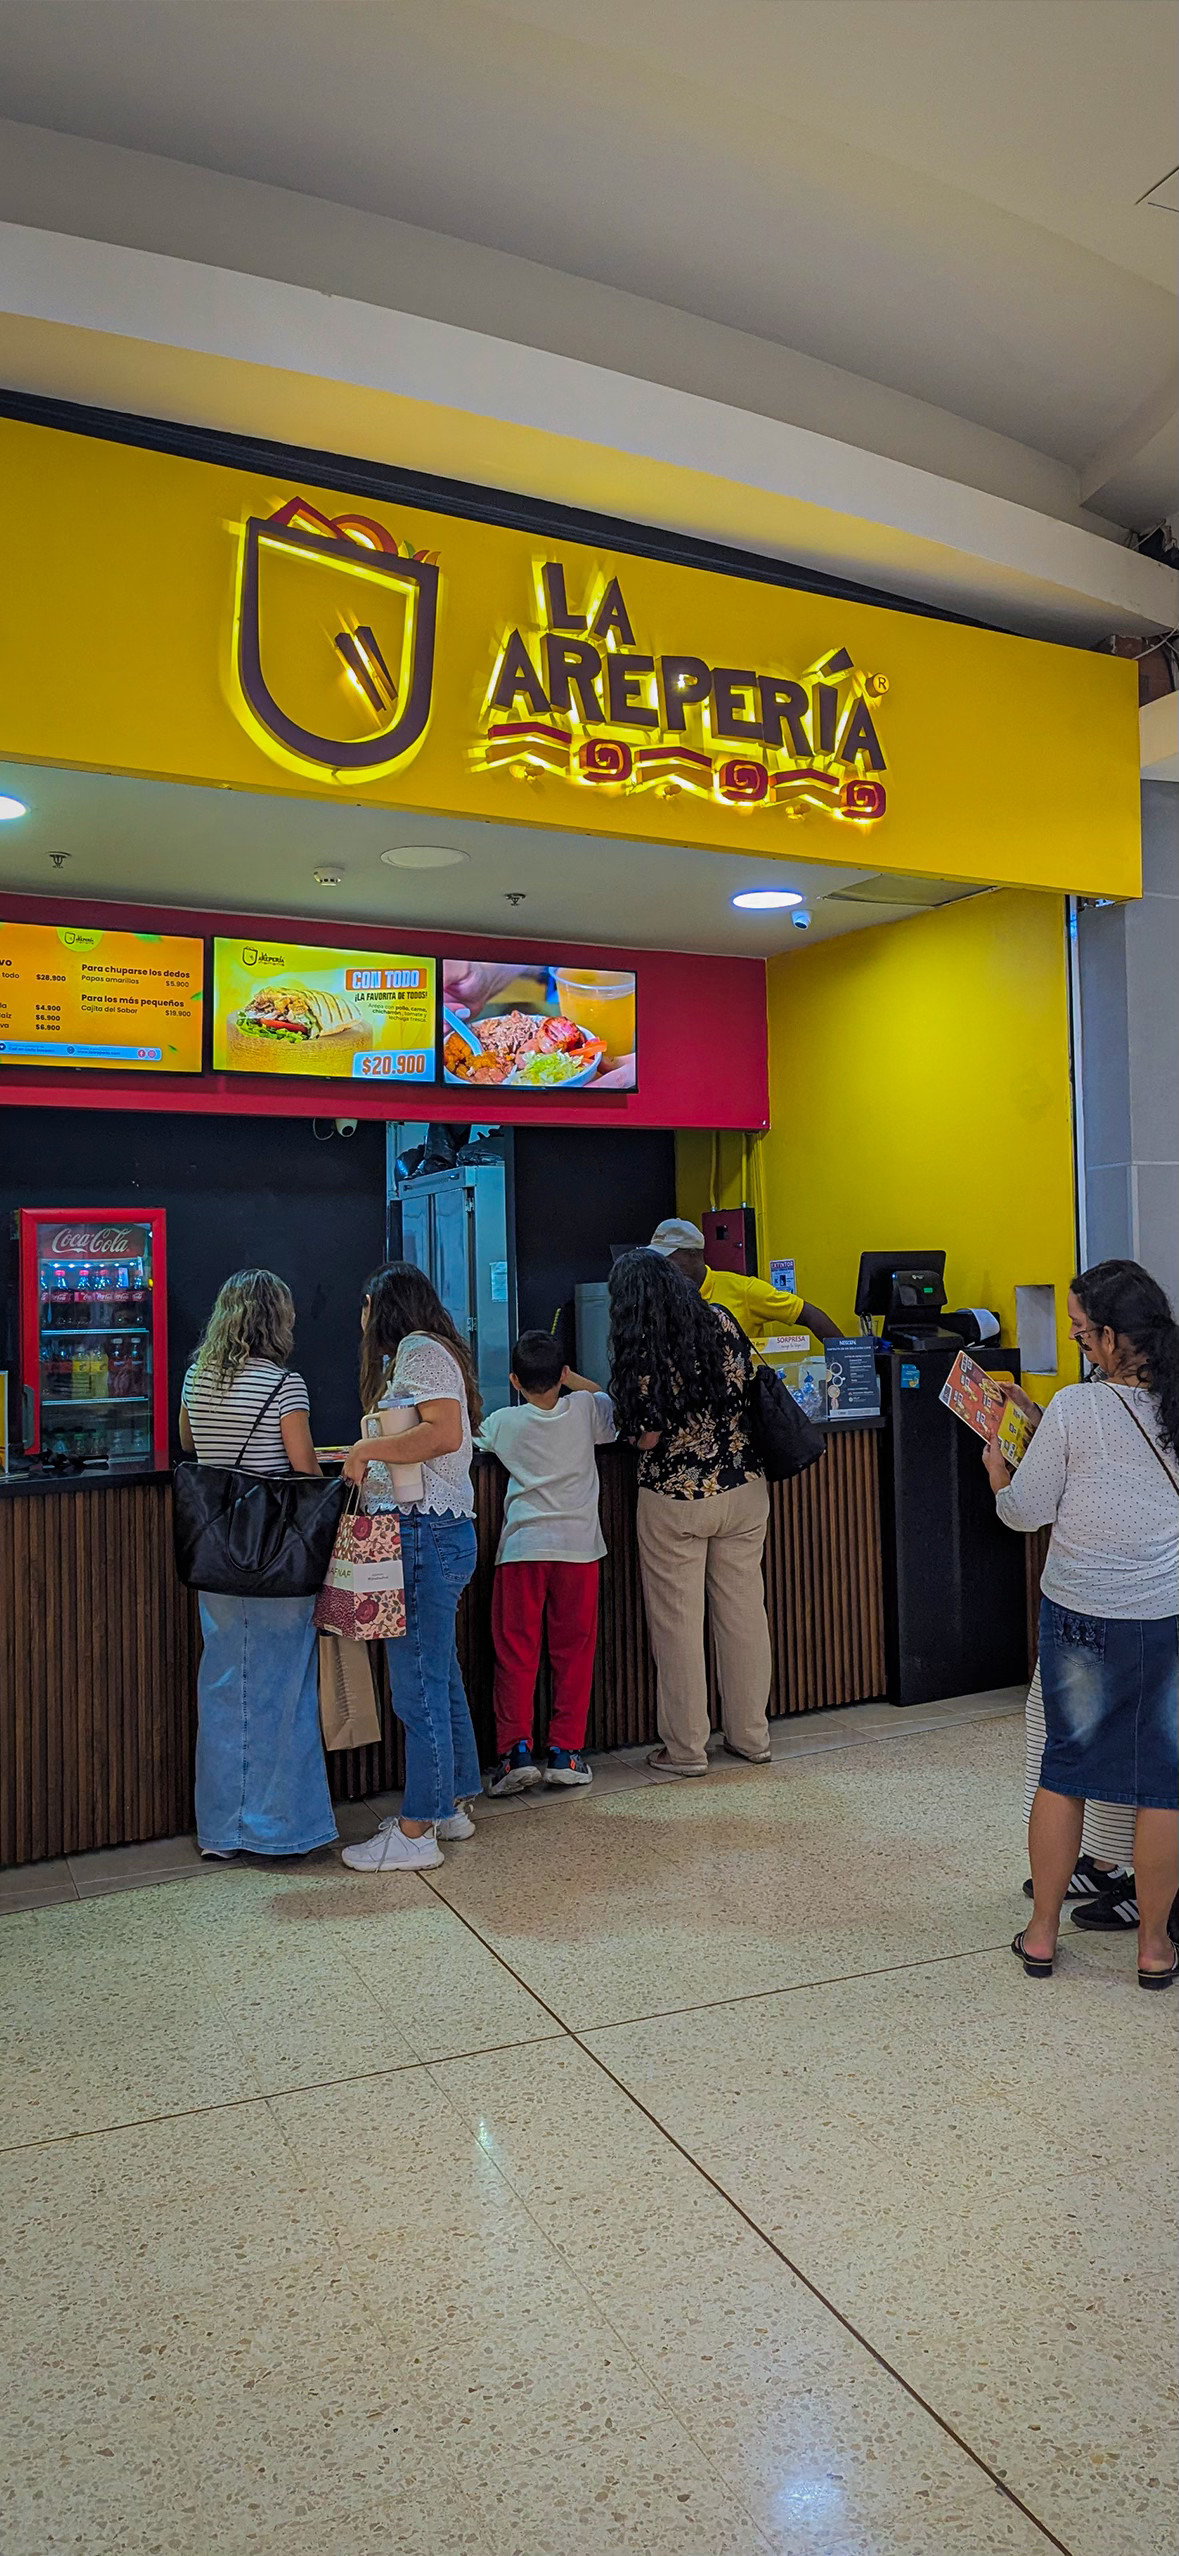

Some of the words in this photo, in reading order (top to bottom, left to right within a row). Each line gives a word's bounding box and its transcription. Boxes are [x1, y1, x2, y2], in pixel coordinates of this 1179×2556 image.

[543, 562, 636, 646] LA
[492, 628, 887, 772] AREPERÍA
[2, 971, 20, 979] todo
[36, 973, 67, 982] $28.900
[81, 964, 103, 972] Para
[104, 966, 148, 976] chuparse
[149, 968, 162, 977] los
[163, 969, 191, 979] dedos
[352, 970, 382, 989] CON
[384, 969, 420, 989] TODO
[81, 974, 104, 983] Papas
[165, 980, 190, 988] $5.900
[81, 994, 103, 1002] Para
[104, 995, 118, 1003] los
[119, 996, 139, 1005] más
[140, 998, 185, 1009] pequeños
[366, 992, 397, 1001] FAVORITA
[397, 992, 406, 1000] DE
[407, 991, 428, 1000] TODOS!
[35, 1004, 62, 1012] $4.900
[81, 1004, 103, 1013] Cajita
[104, 1005, 116, 1013] del
[117, 1006, 138, 1014] Sabor
[165, 1009, 192, 1018] $19.900
[361, 1054, 426, 1075] $20.900
[52, 1228, 134, 1253] Coca-Cola
[776, 1335, 806, 1344] SORPRESA
